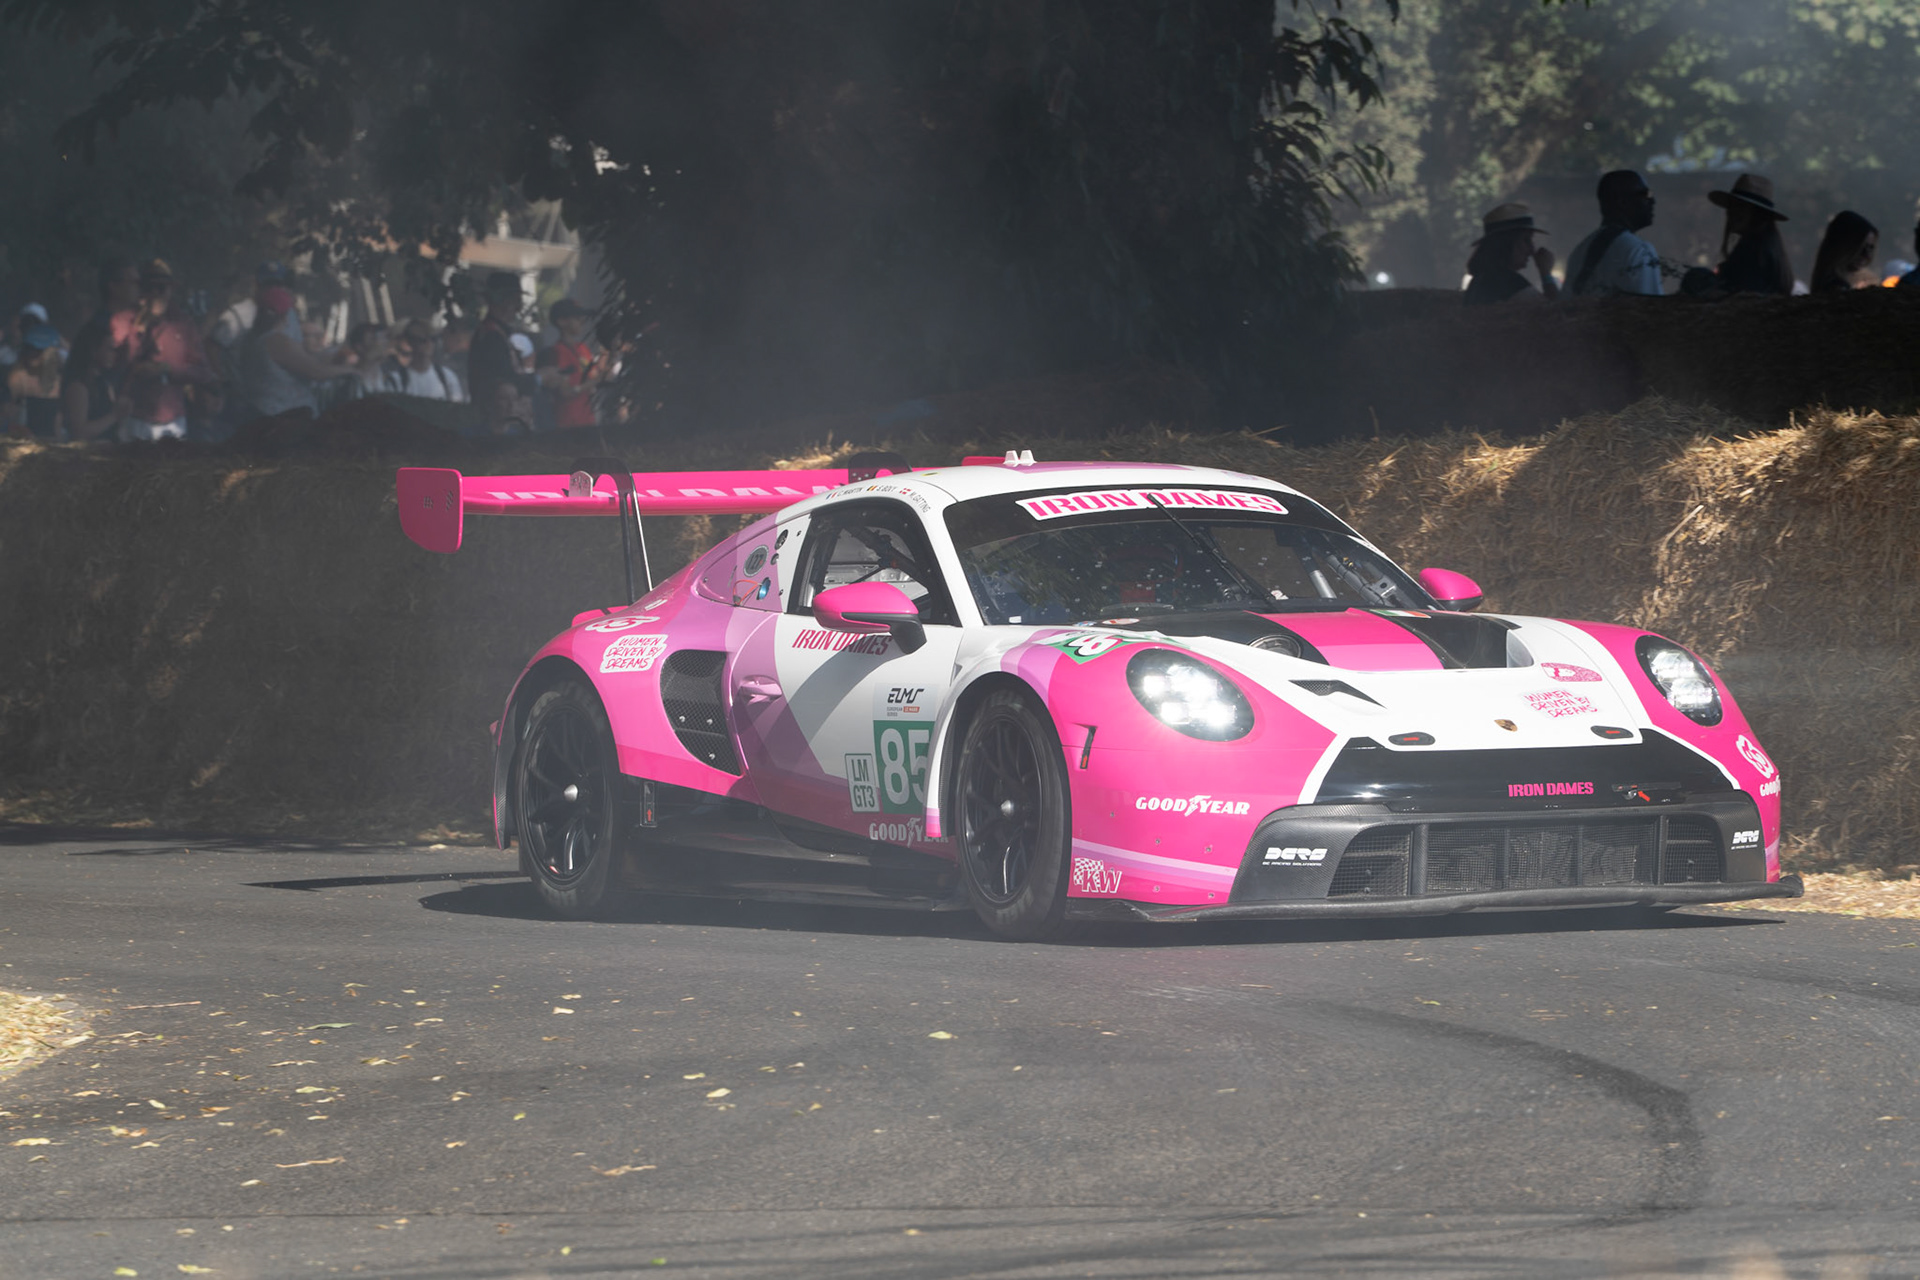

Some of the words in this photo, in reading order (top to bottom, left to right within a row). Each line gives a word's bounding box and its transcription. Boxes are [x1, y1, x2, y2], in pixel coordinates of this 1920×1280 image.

[1027, 492, 1137, 517] IRON
[1141, 491, 1285, 512] DAMES
[618, 636, 662, 646] WOMEN
[792, 629, 835, 651] IRON
[832, 633, 893, 656] DAMES
[606, 647, 645, 657] DRIVEN
[646, 647, 662, 658] BY
[605, 658, 650, 669] DREAMS
[1524, 689, 1573, 702] WOMEN
[1531, 698, 1576, 711] DRIVEN
[1548, 706, 1598, 718] DREAMS
[851, 758, 869, 782] LM
[881, 728, 930, 805] 85
[853, 785, 875, 808] GT3
[1508, 783, 1545, 797] IRON
[1546, 781, 1594, 796] DAMES
[1136, 796, 1250, 816] GOODYEAR
[1082, 870, 1122, 894] KW
